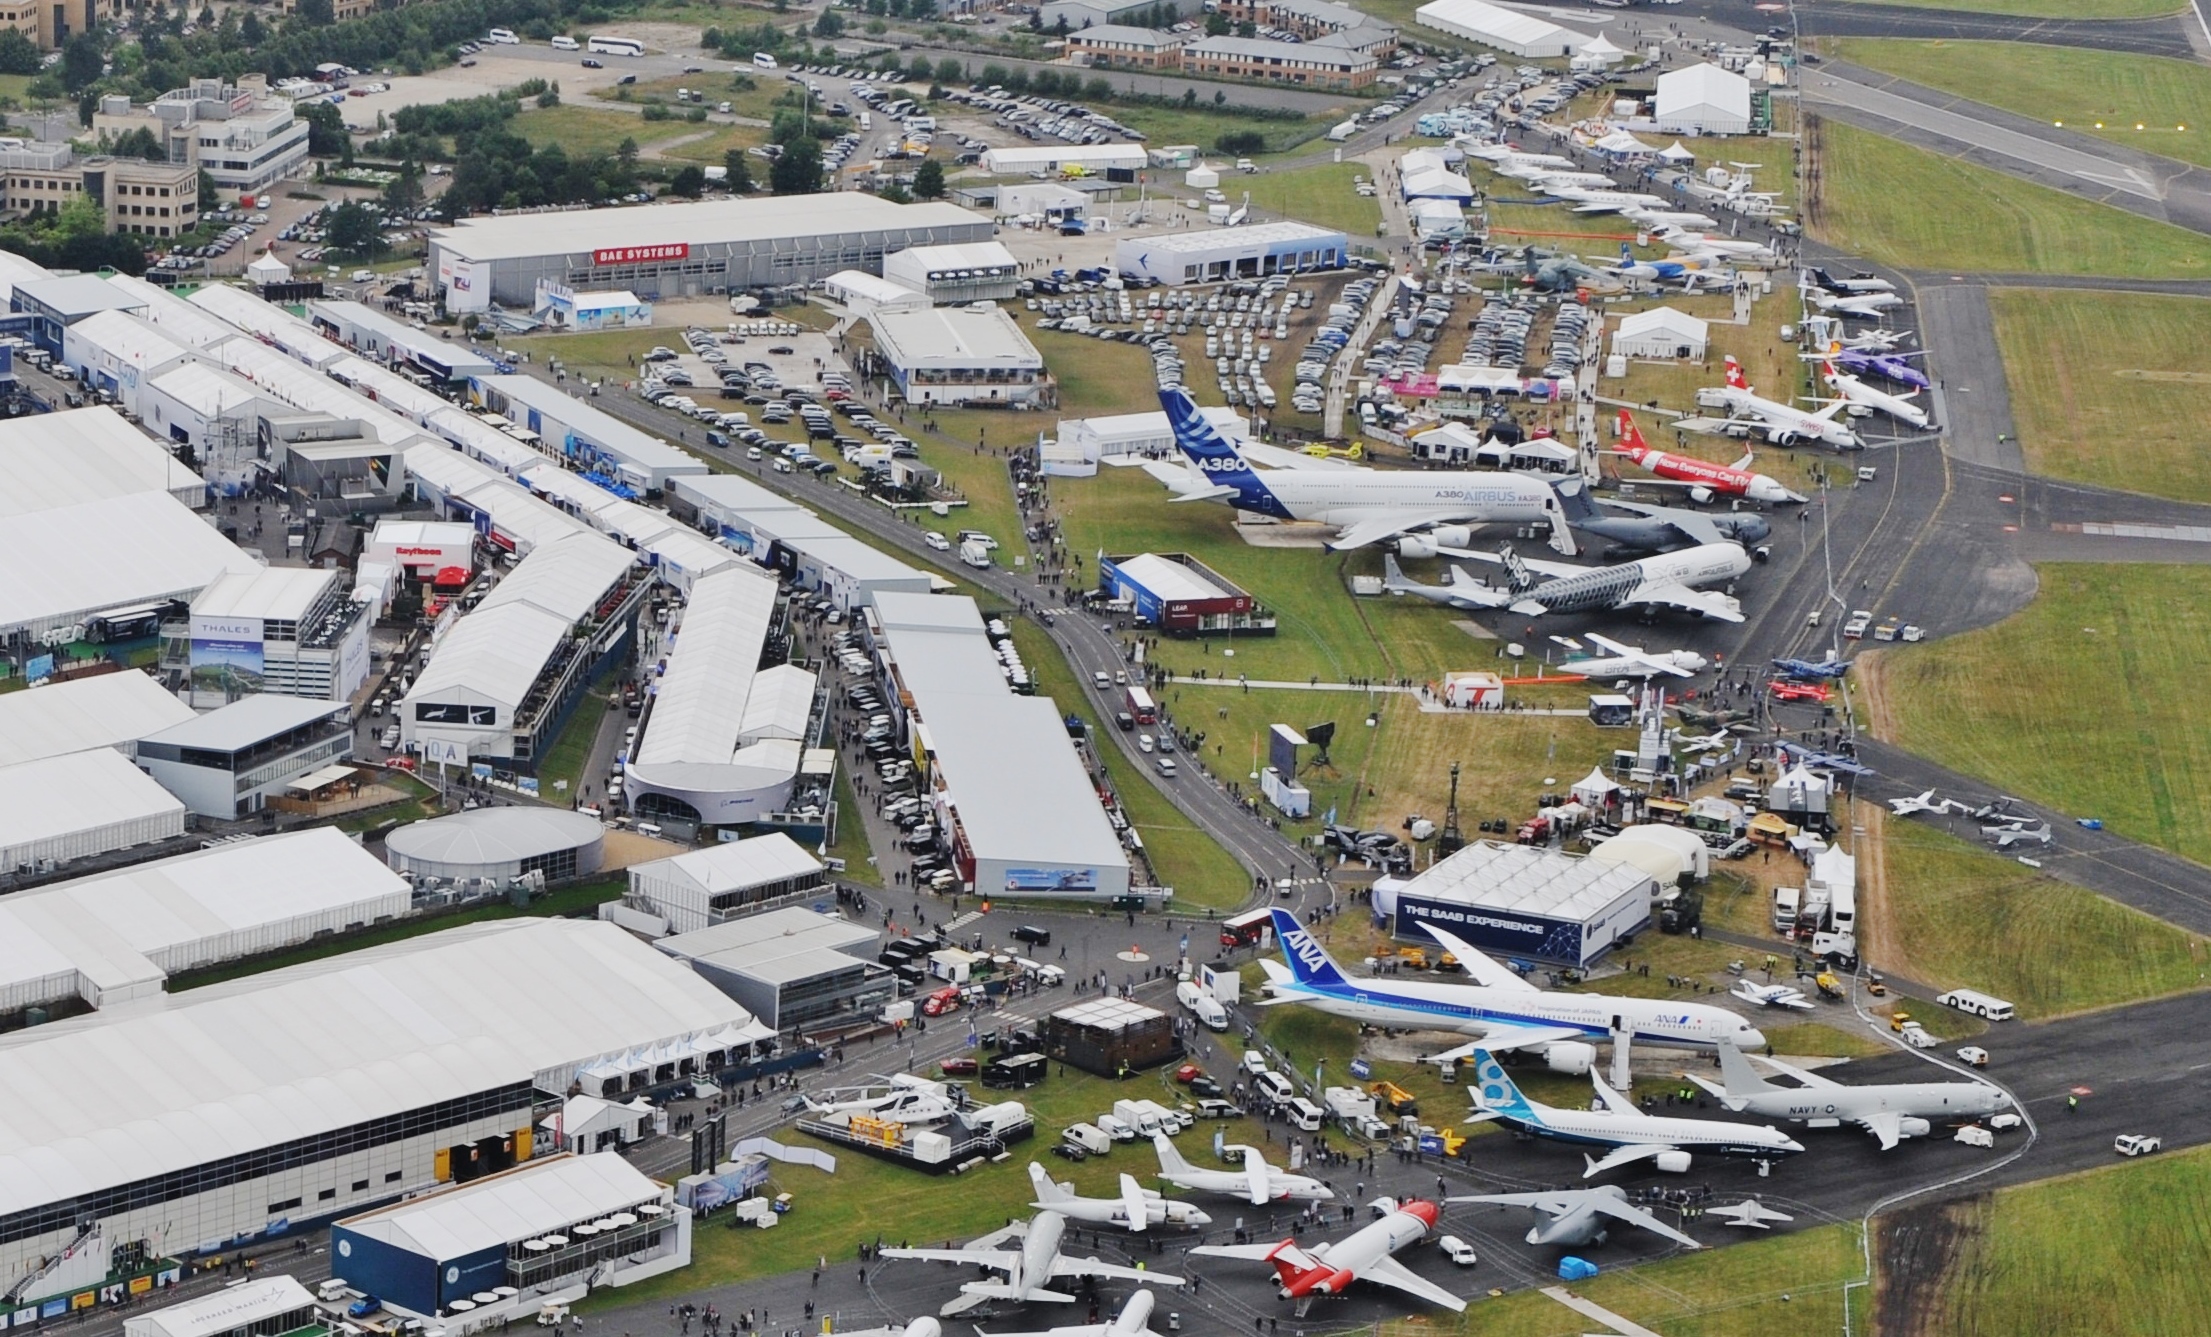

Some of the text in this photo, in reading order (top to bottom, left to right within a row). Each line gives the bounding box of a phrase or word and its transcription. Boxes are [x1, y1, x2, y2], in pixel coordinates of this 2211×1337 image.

[600, 246, 683, 262] BAE SYSTEMS
[1198, 457, 1248, 472] A380
[1435, 490, 1464, 499] A380
[1463, 490, 1516, 502] AIRBUS
[395, 547, 442, 556] Raytheon
[1500, 546, 1531, 587] A350
[42, 623, 86, 648] GREA
[201, 624, 251, 634] THALES
[1404, 904, 1544, 935] THE SAAB EXPERIENCE
[1281, 930, 1327, 974] ANA
[1654, 1014, 1678, 1024] ANA
[1789, 1105, 1817, 1115] NAVY
[190, 1298, 268, 1324] LOCKHEED MARTIN
